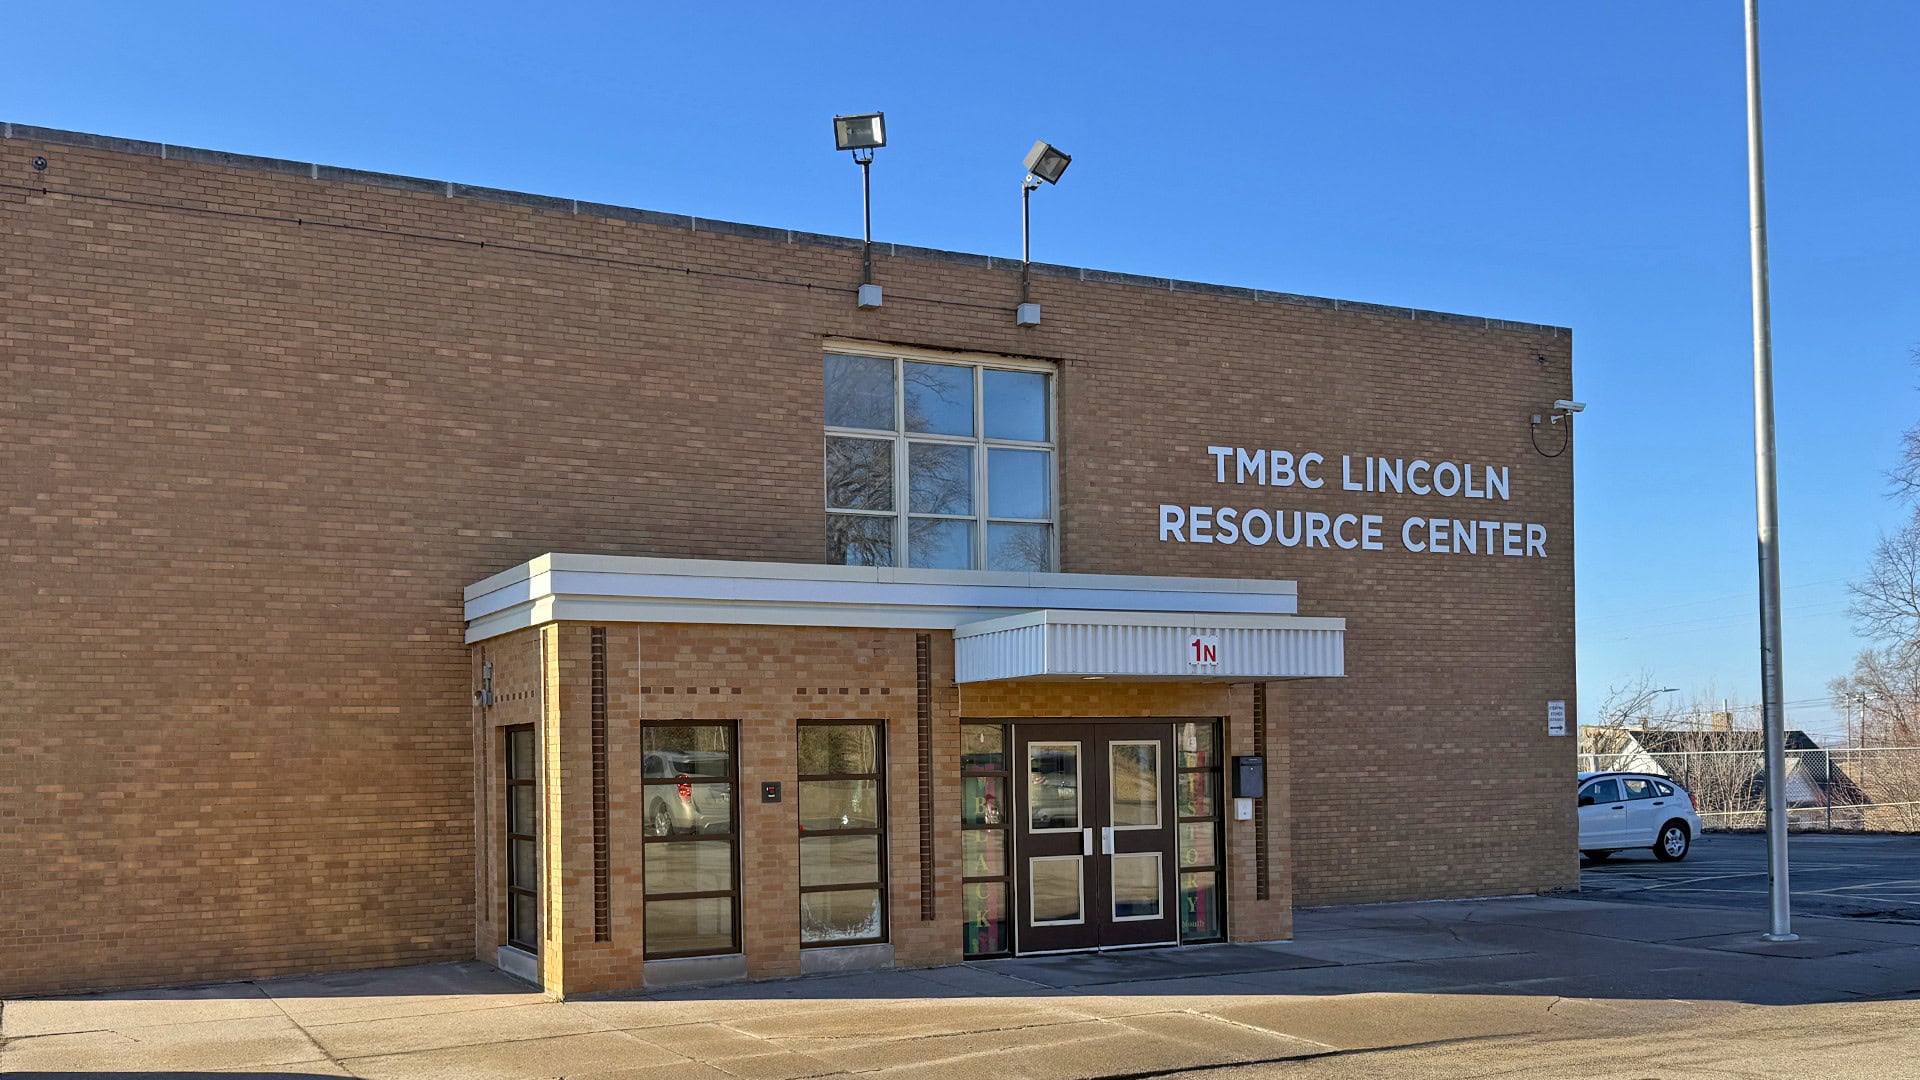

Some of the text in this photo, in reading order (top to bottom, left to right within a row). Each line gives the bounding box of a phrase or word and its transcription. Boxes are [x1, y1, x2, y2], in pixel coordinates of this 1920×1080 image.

[1207, 446, 1510, 501] TMBC LINCOLN
[1159, 504, 1548, 558] RESOURCE CENTER
[1191, 638, 1217, 662] 1N
